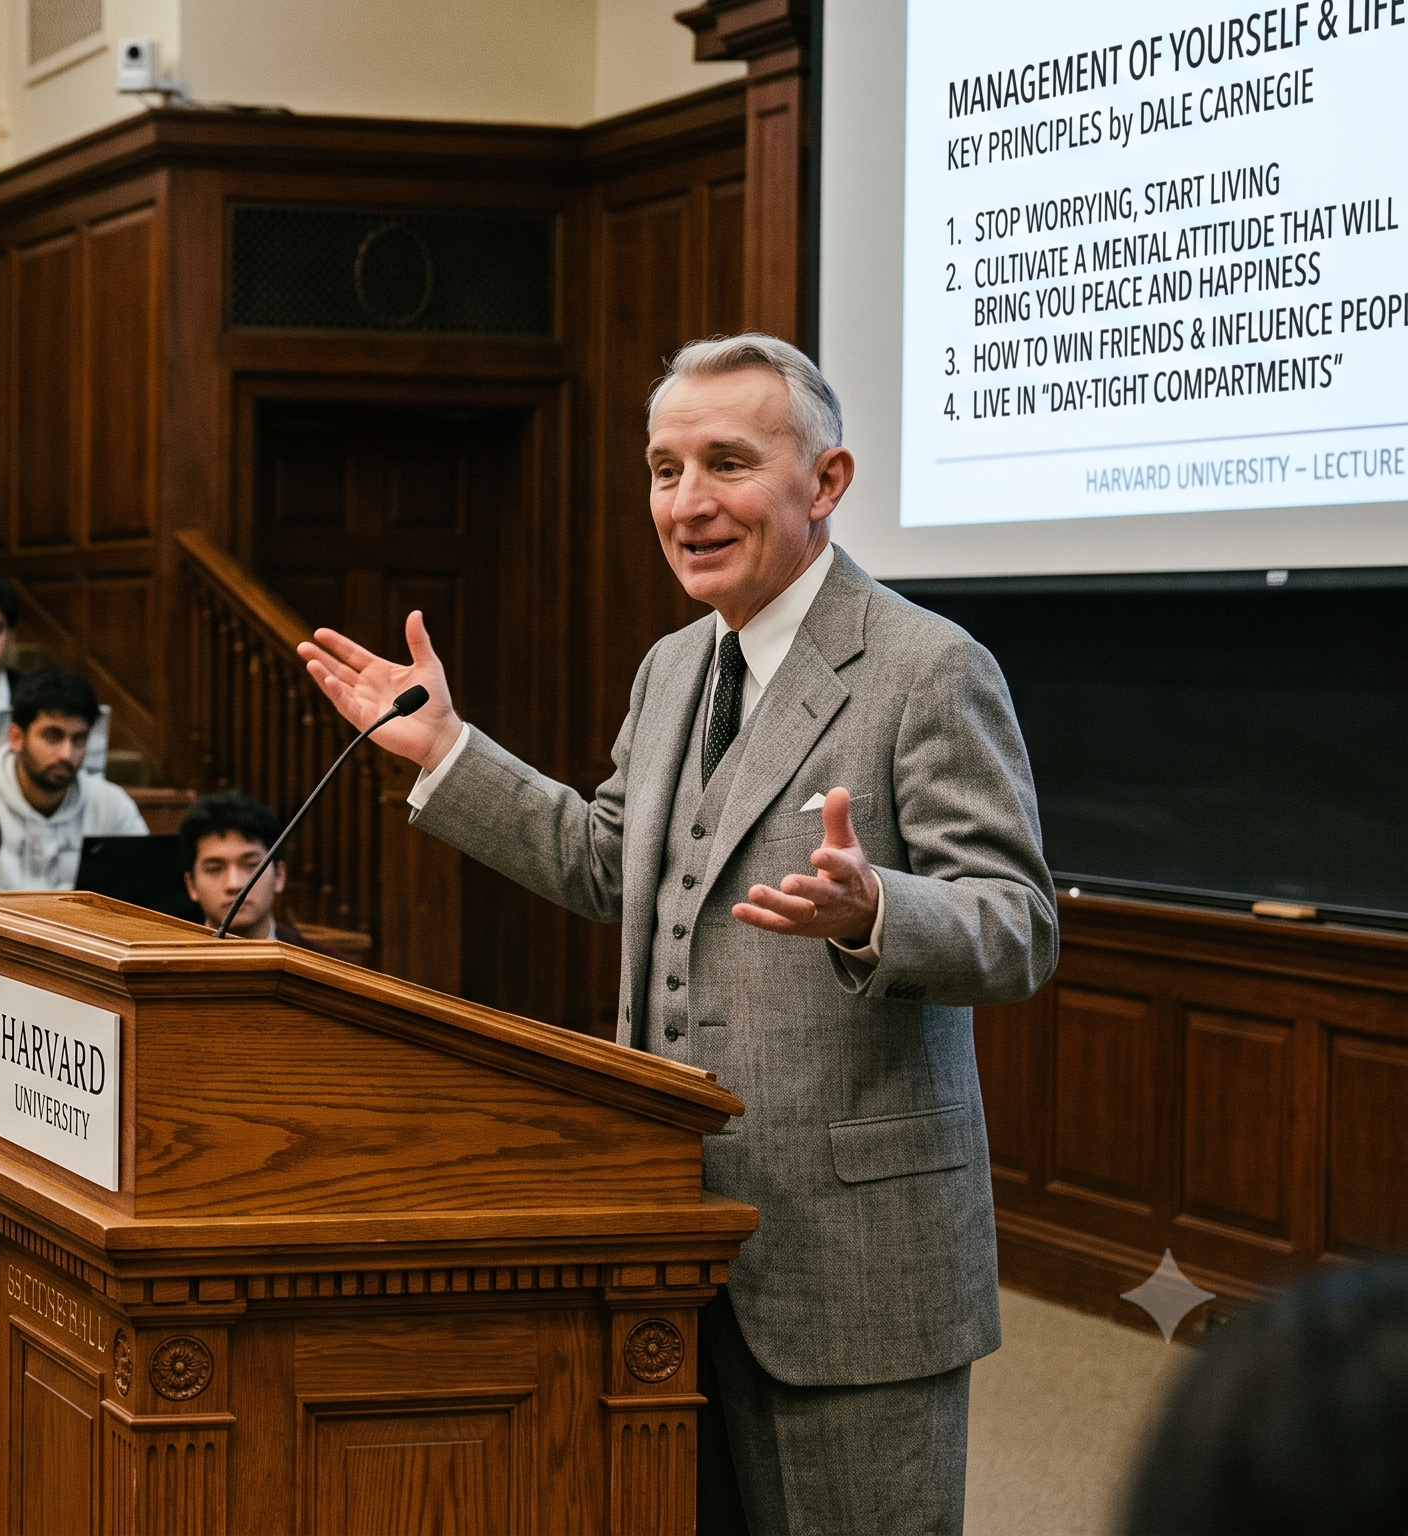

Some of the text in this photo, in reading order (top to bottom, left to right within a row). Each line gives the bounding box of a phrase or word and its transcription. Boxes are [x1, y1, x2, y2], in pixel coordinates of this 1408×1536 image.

[948, 0, 1406, 119] MANAGEMENT OF YOURSELF & LIFE
[948, 67, 1314, 171] KEY PRINCIPLES by DALE CARNEGIE
[945, 196, 1399, 292] 2. CULTIVATE A MENTAL ATTITUDE THAT WILL
[946, 162, 1280, 246] 1. STOP WORRYING, START LIVING
[974, 251, 1321, 327] BRING YOU PEACE AND HAPPINESS
[944, 292, 1408, 376] 3. HOW TO WIN FRIENDS & INFLUENCE PEOP
[943, 390, 960, 422] 4.
[973, 386, 1011, 419] LIVE
[1017, 384, 1036, 416] IN
[1086, 464, 1171, 493] HARVARD
[1177, 455, 1290, 489] UNIVERSITY
[1313, 447, 1405, 480] LECTURE
[1, 1013, 105, 1096] HARVARD
[14, 1083, 91, 1141] UNIVERSITY
